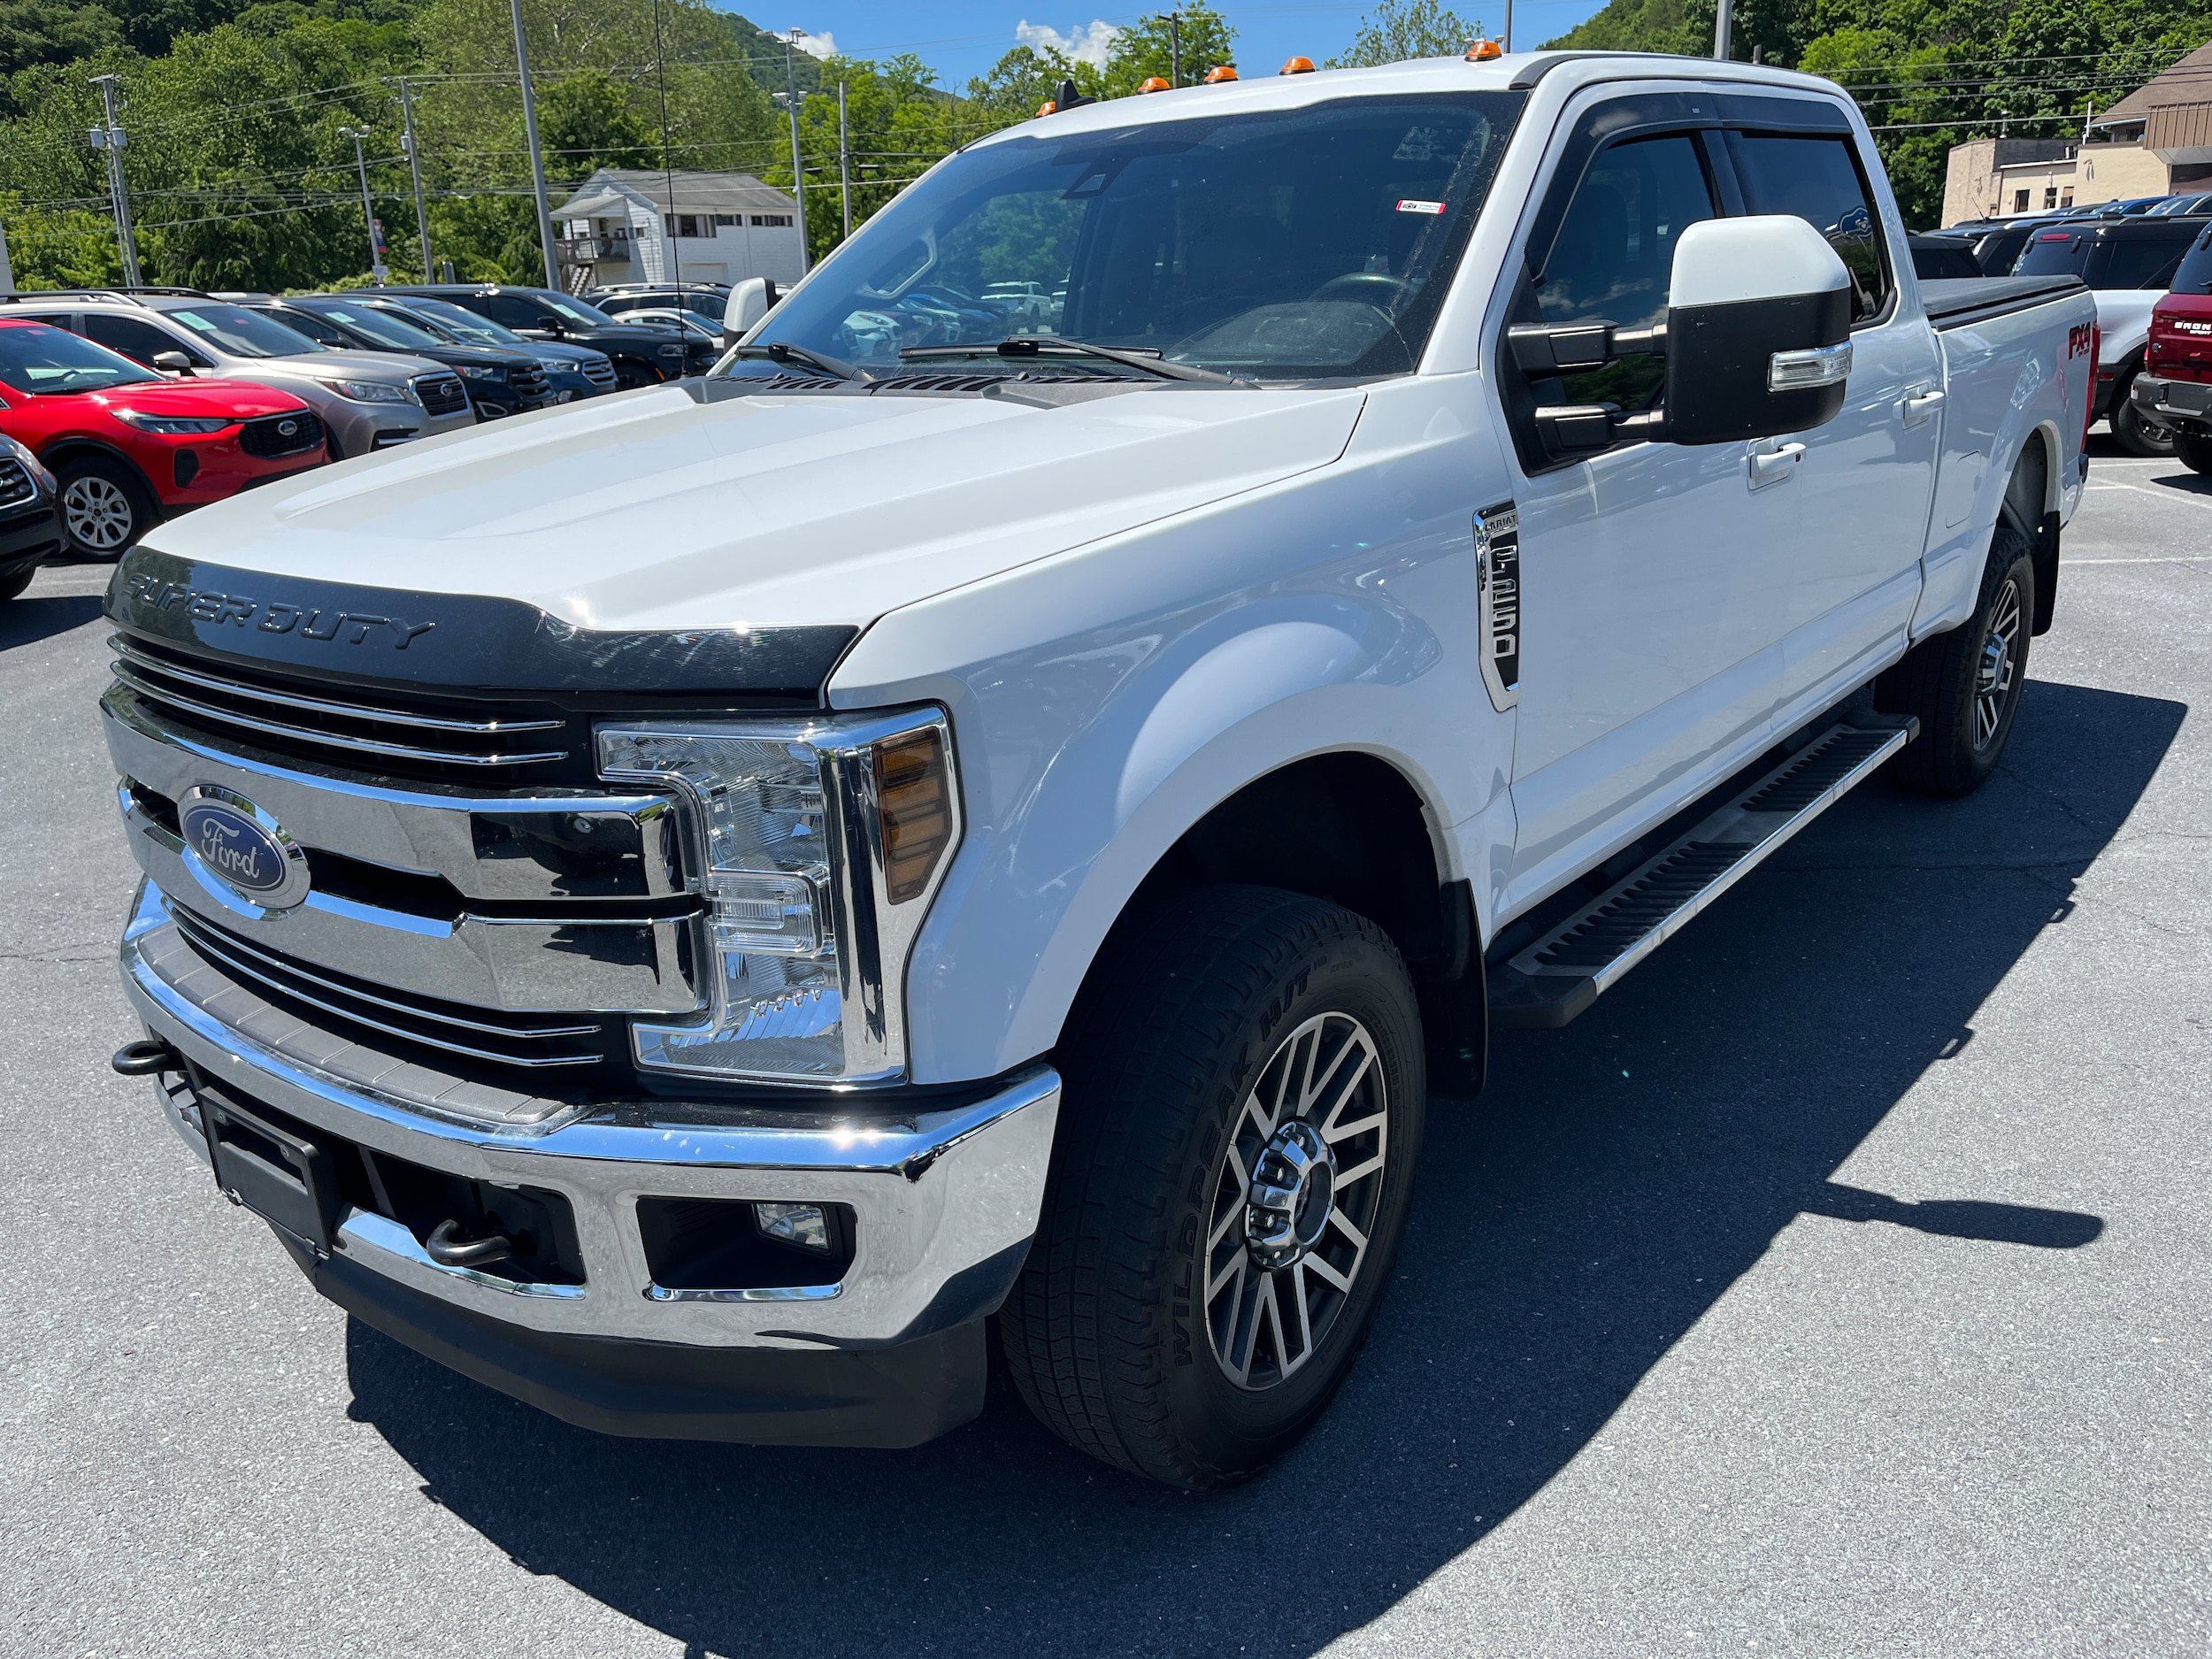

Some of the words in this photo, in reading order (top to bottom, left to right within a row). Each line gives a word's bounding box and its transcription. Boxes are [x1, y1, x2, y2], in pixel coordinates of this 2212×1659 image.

[2069, 321, 2091, 360] FX4
[1485, 514, 1517, 531] LARIAT
[121, 572, 257, 627] SUPER
[257, 603, 435, 649] DUTY
[1491, 545, 1517, 658] F-250
[201, 818, 260, 879] Ford
[1173, 1041, 1253, 1368] WILDPEAK
[1259, 964, 1312, 1042] H/T
